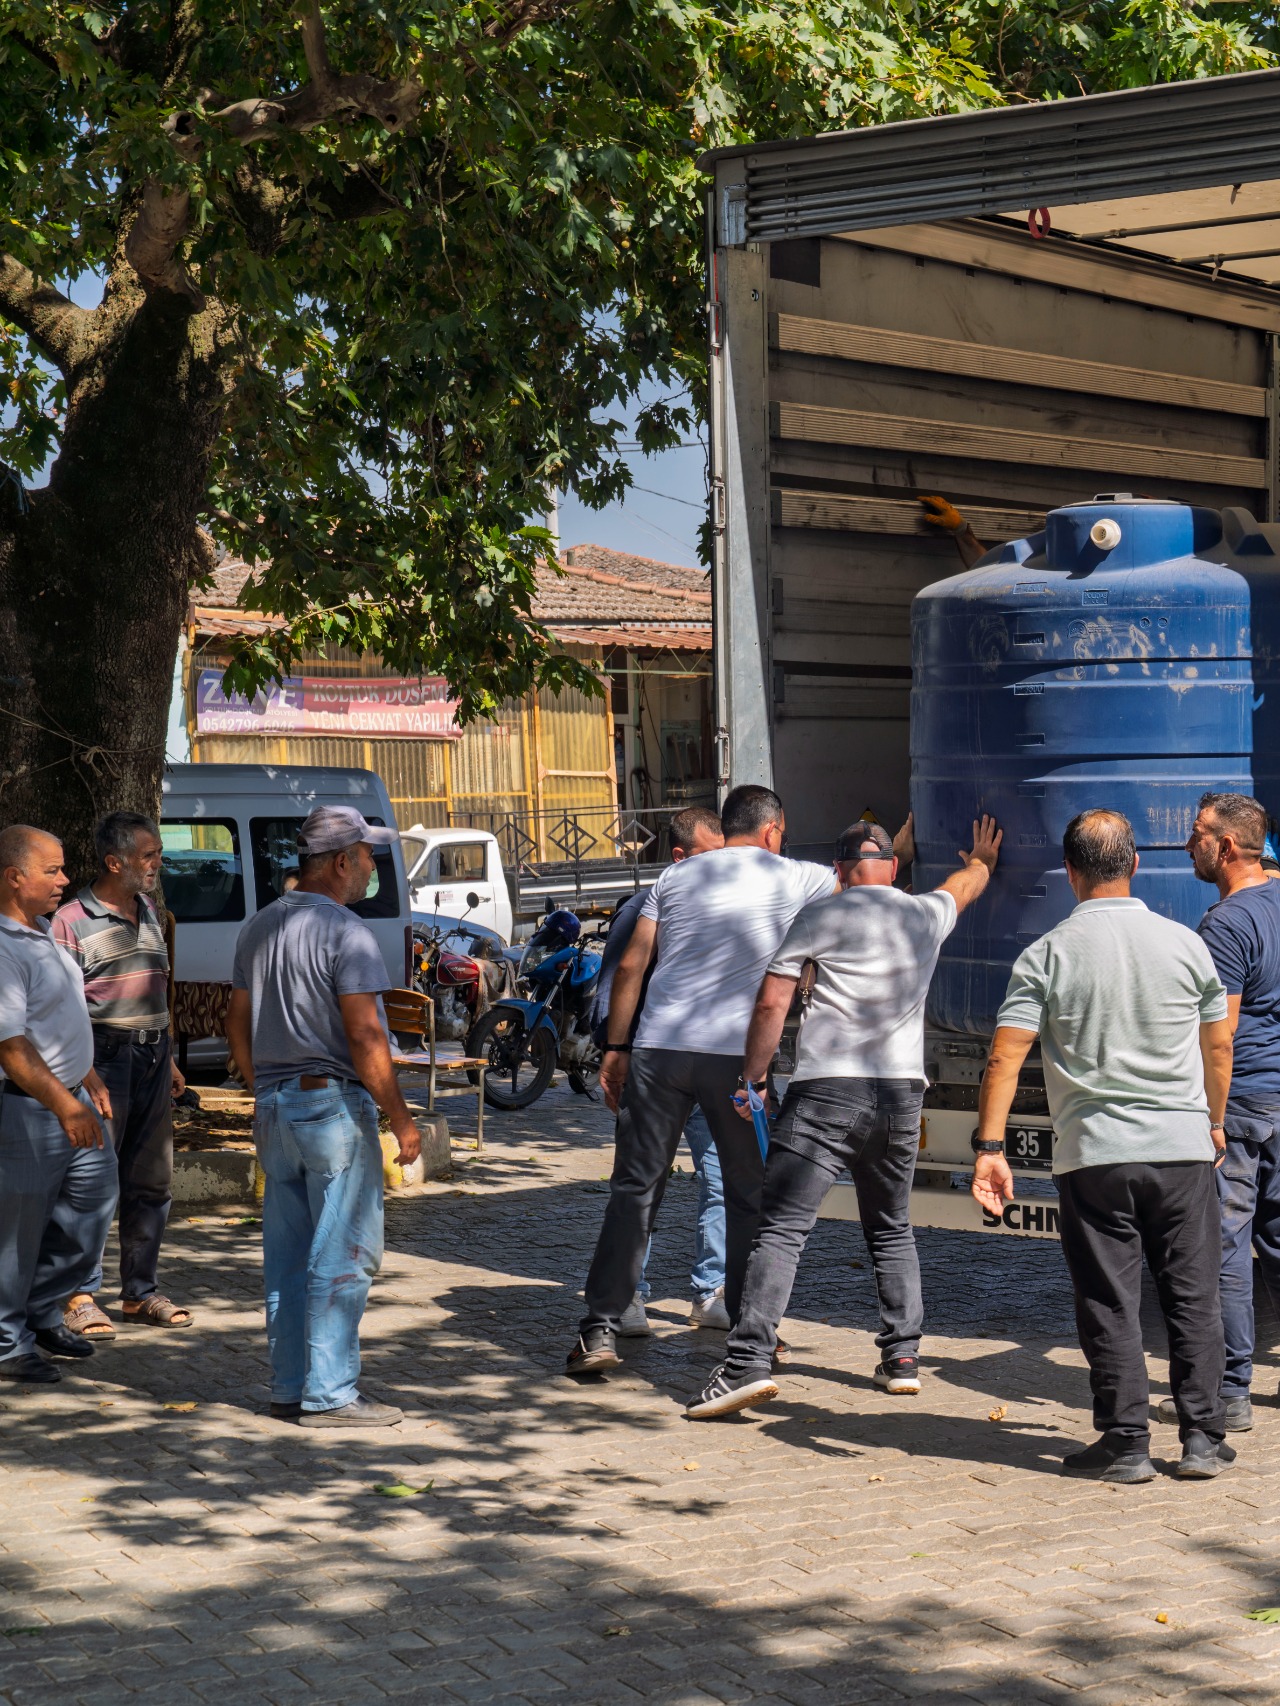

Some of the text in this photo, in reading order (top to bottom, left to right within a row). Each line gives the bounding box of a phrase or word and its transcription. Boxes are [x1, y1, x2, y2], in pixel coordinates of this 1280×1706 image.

[311, 683, 380, 704] KOLTUK
[202, 717, 259, 732] 0542796
[310, 706, 346, 729] YENİ
[350, 711, 402, 734] ÇEKYAT
[1016, 1130, 1040, 1157] 35
